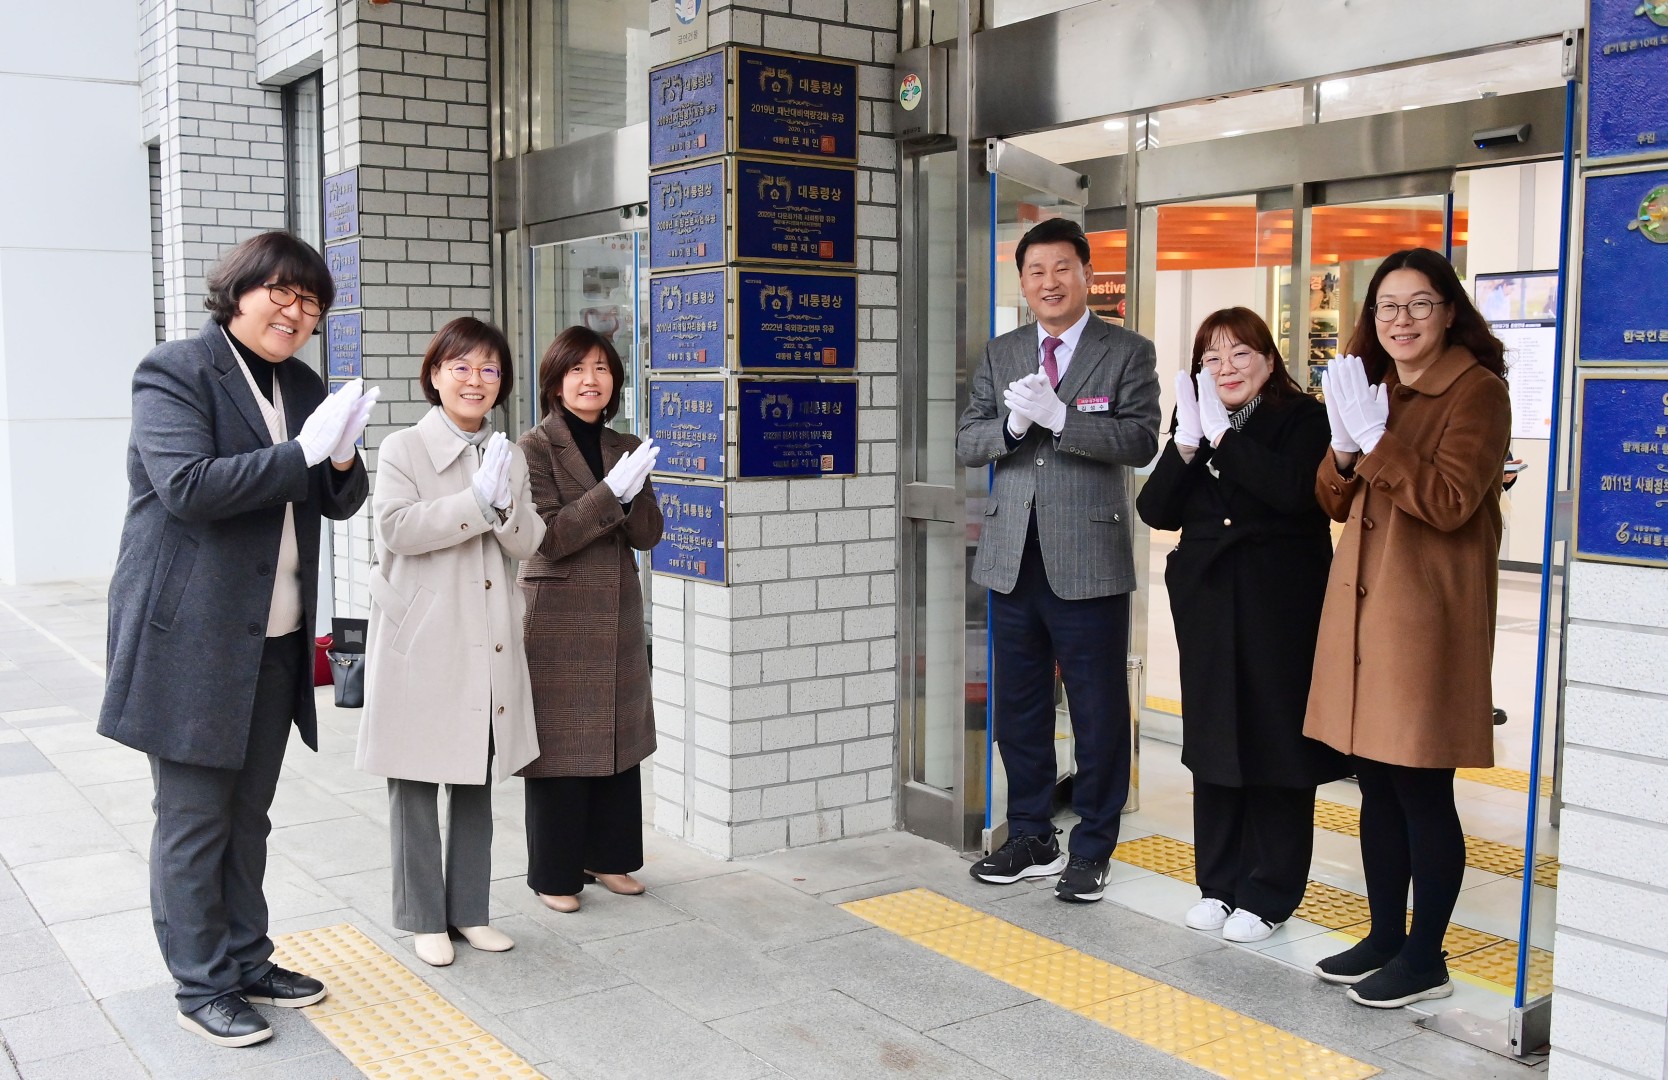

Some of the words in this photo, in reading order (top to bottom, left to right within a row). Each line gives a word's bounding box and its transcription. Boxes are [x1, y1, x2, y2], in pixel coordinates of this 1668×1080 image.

[684, 73, 713, 91] 대통령상
[799, 79, 843, 96] 대통령상
[751, 103, 775, 115] 2019년
[777, 106, 829, 121] 재난대비역량강화
[831, 112, 845, 123] 유공
[683, 183, 713, 199] 대통령상
[798, 184, 841, 201] 대통령상
[705, 214, 717, 225] 유공
[757, 210, 776, 219] 2020년
[825, 215, 836, 224] 유공
[771, 242, 789, 251] 대통령
[1087, 282, 1126, 294] estiva
[685, 291, 715, 305] 대통령상
[799, 294, 842, 309] 대통령상
[707, 321, 718, 331] 유공
[761, 323, 783, 332] 2022년
[785, 323, 820, 333] 옥외광고업무
[822, 324, 834, 334] 유공
[684, 400, 713, 413] 대통령상
[1623, 441, 1658, 454] 함께해서
[1600, 474, 1632, 492] 2011년
[683, 503, 712, 519] 대통령상
